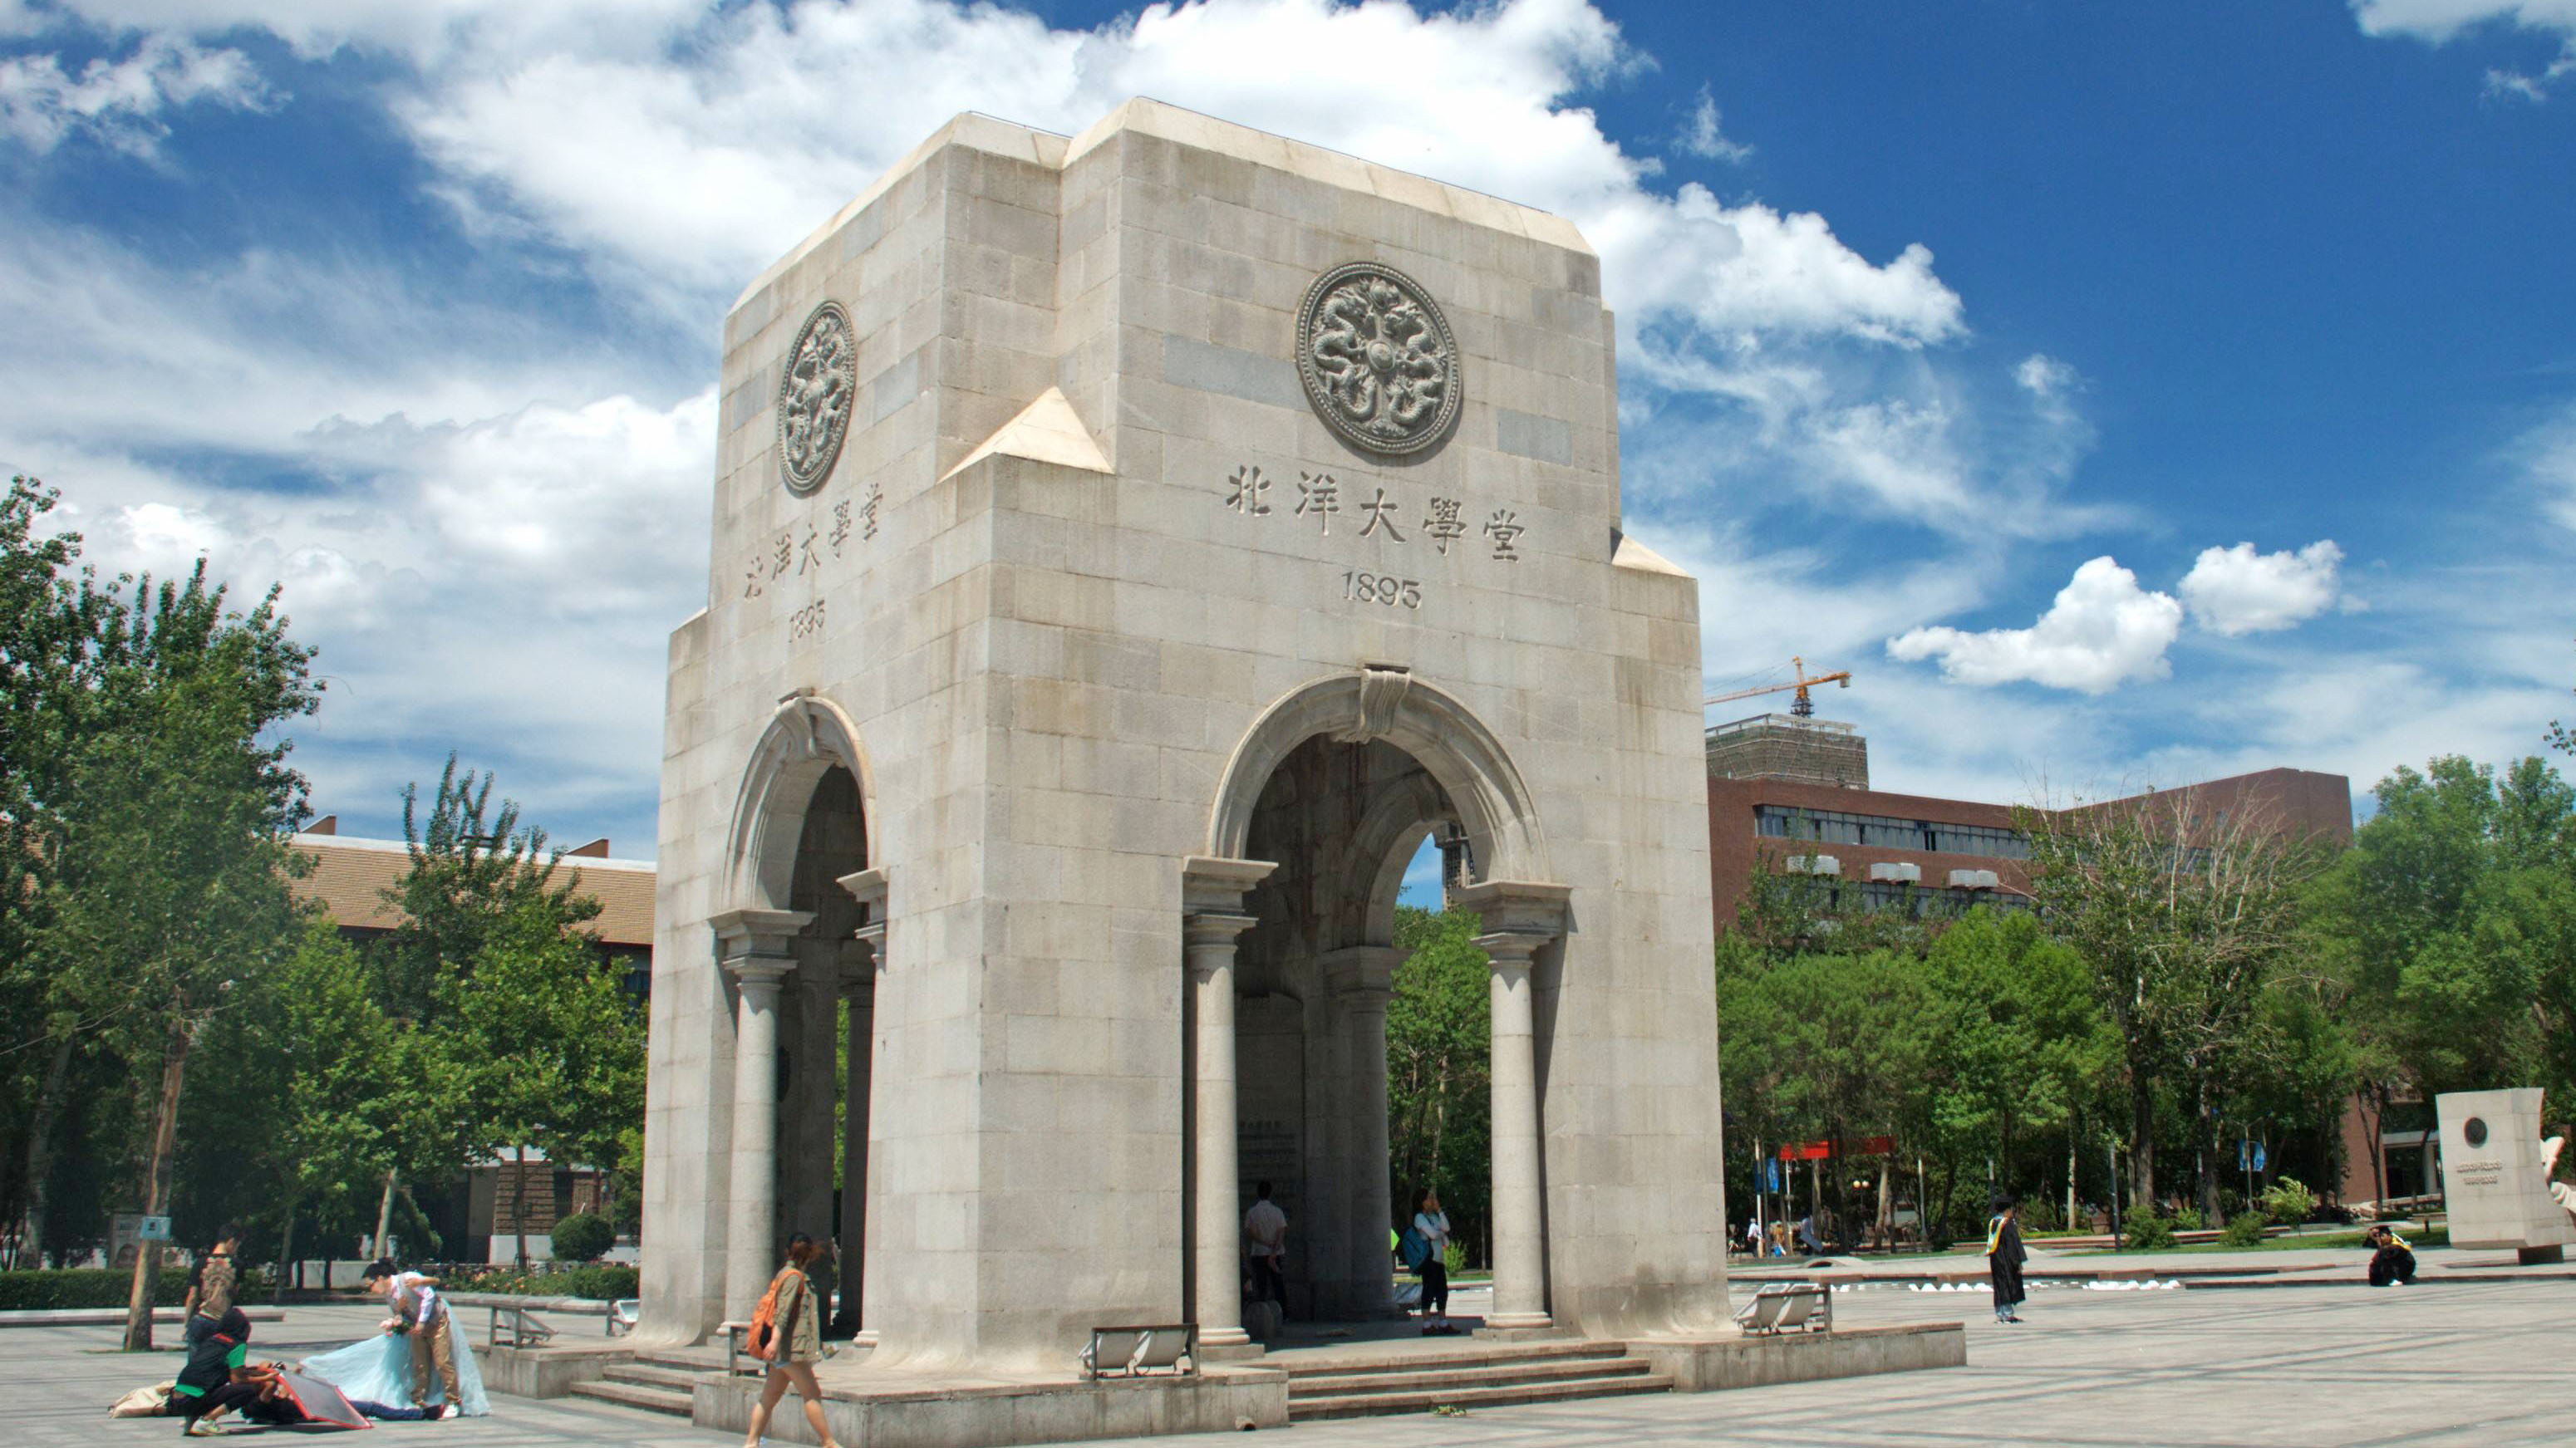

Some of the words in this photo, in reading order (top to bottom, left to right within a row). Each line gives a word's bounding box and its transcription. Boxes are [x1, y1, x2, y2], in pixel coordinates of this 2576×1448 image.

[1227, 464, 1526, 563] 北洋大學堂
[1341, 571, 1422, 610] 1895
